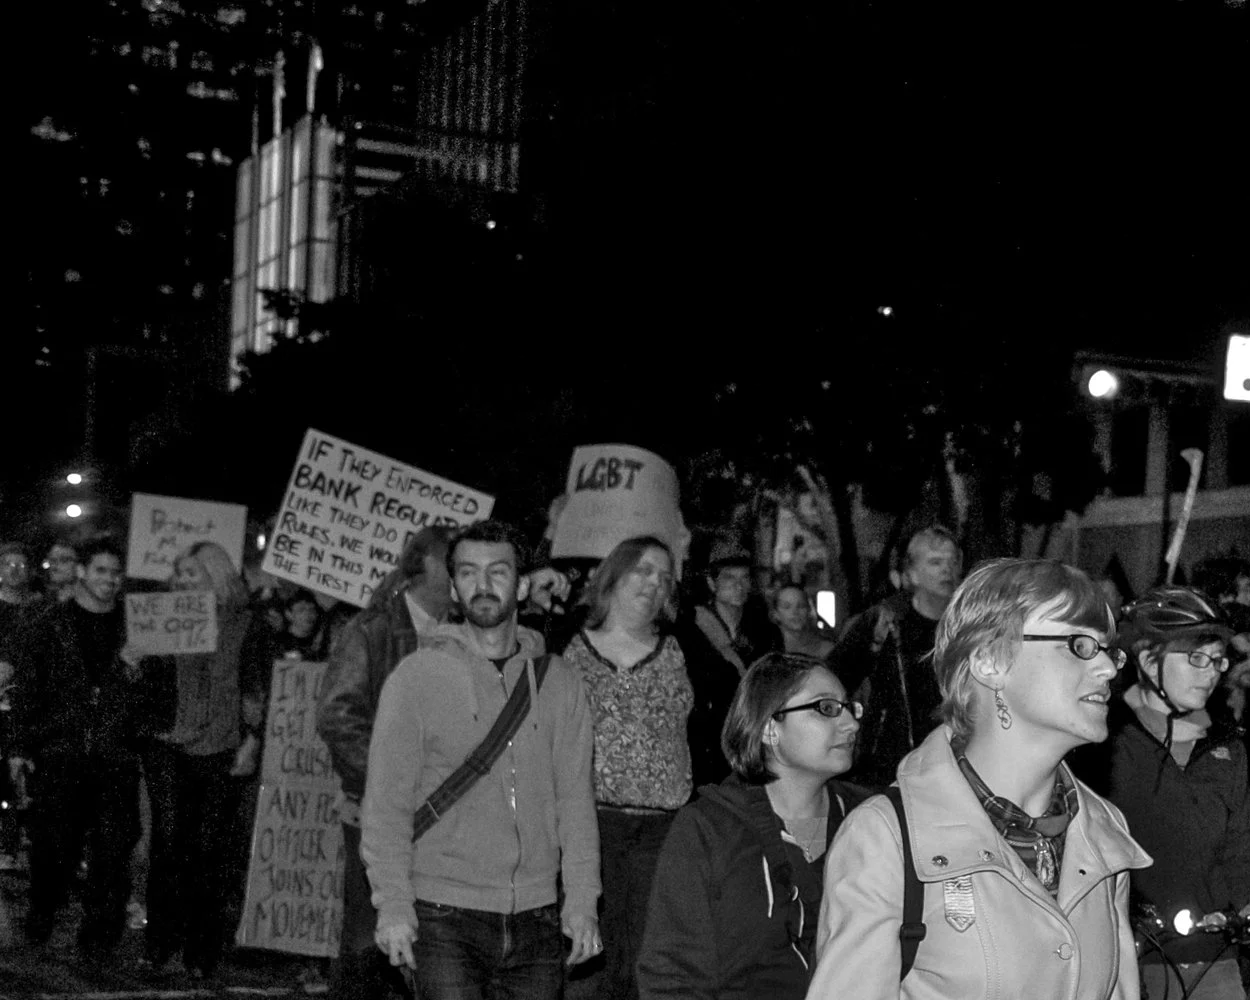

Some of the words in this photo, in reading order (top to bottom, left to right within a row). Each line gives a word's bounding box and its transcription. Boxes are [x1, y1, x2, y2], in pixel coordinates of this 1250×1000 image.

[293, 463, 362, 508] BANK
[307, 438, 334, 461] IF
[339, 448, 381, 481] THEY
[385, 466, 479, 515] ENFORCED
[575, 456, 645, 492] LGBT
[287, 491, 321, 517] LIKE
[329, 505, 369, 532] THEY
[373, 522, 398, 543] DO
[274, 534, 301, 556] BE
[307, 547, 324, 564] IN
[330, 553, 363, 575] THIS
[340, 535, 364, 553] WE
[271, 552, 300, 574] THE
[306, 565, 352, 594] FIRST
[128, 597, 163, 617] WE
[172, 595, 209, 616] ARE
[267, 786, 311, 821] ANY
